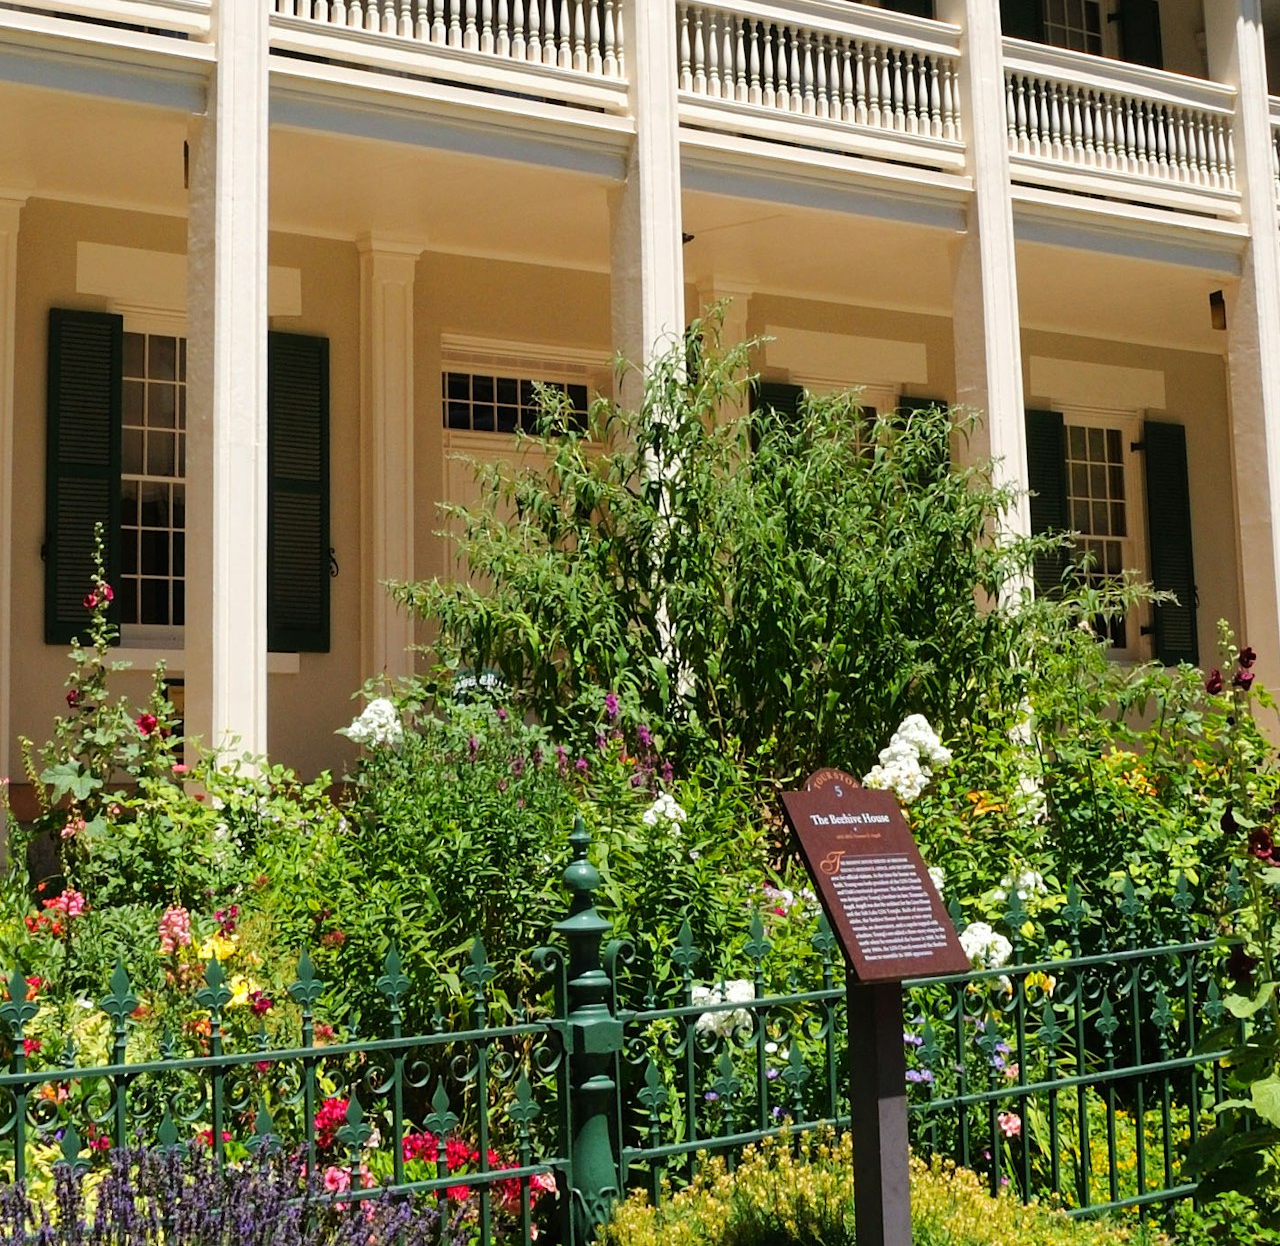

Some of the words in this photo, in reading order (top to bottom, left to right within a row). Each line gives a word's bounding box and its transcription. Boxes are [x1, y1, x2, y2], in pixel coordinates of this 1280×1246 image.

[814, 771, 833, 789] TOUR
[834, 785, 843, 797] 5
[809, 814, 830, 825] The
[828, 813, 863, 824] Beehive
[861, 813, 890, 823] House
